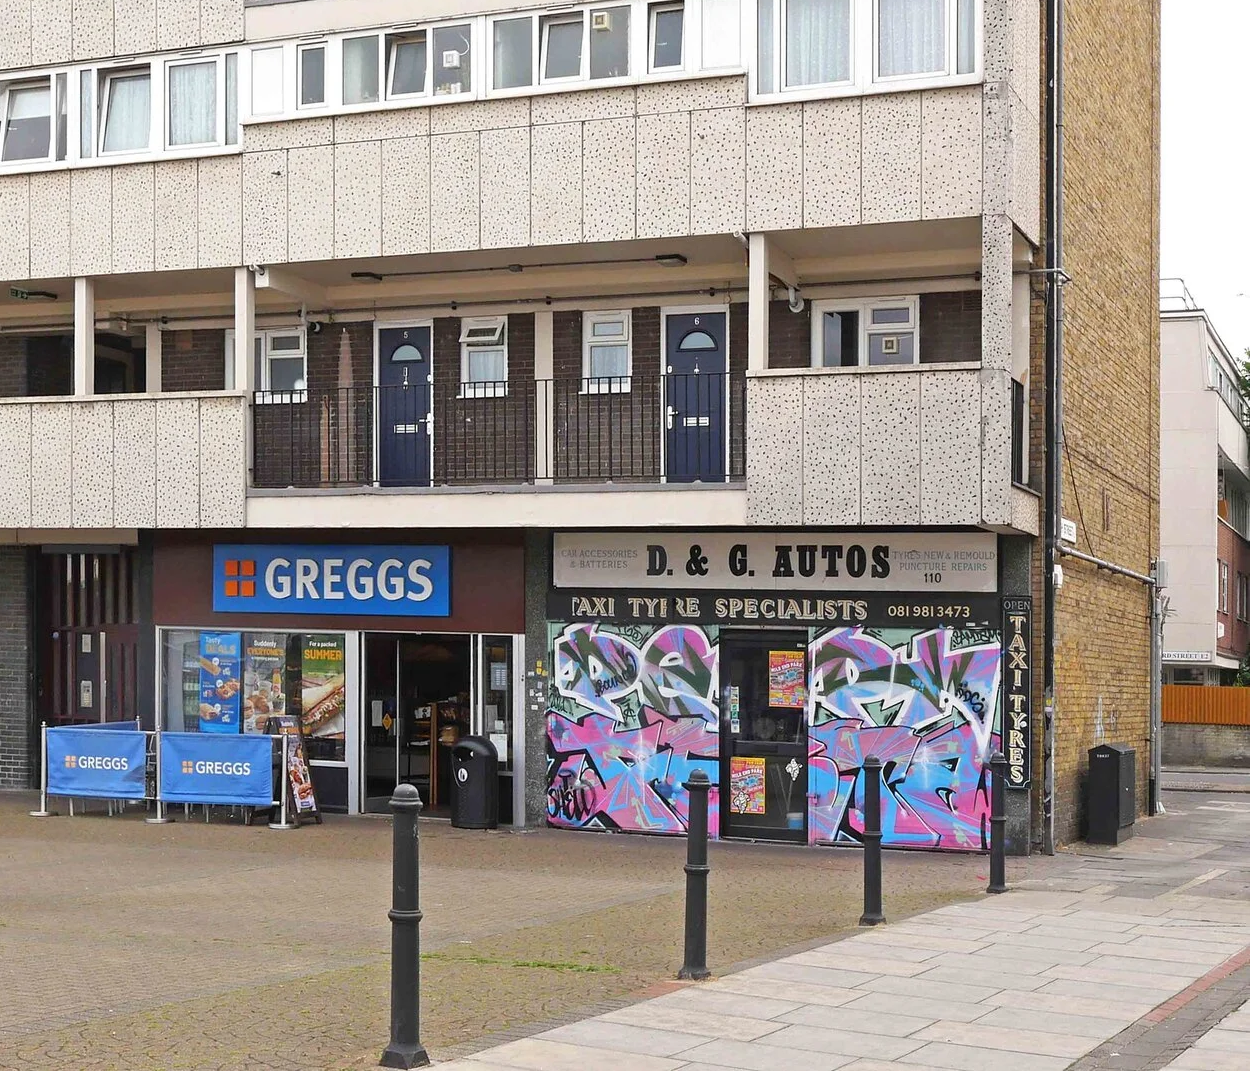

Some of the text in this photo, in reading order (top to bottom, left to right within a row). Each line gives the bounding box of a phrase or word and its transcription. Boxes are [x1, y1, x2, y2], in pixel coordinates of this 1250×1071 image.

[694, 317, 700, 325] 6
[562, 550, 638, 558] CAR ACCESSORIES
[892, 550, 921, 560] TYRES
[924, 550, 944, 560] NEW
[954, 551, 995, 560] REMOULD
[570, 560, 628, 569] & BATTERIES
[646, 544, 891, 578] D. & G. AUTOS
[900, 562, 988, 571] PUNCTURE REPAIRS
[265, 558, 434, 602] GREGGS
[924, 572, 942, 584] 110
[715, 598, 868, 621] SPECIALISTS
[1004, 600, 1030, 610] OPEN
[888, 606, 970, 618] 081 981 3473
[304, 649, 342, 660] SUMMER
[1008, 615, 1028, 687] TAXI
[1008, 694, 1028, 783] TYRES
[78, 756, 128, 770] GREGGS
[196, 760, 250, 776] GREGGS
